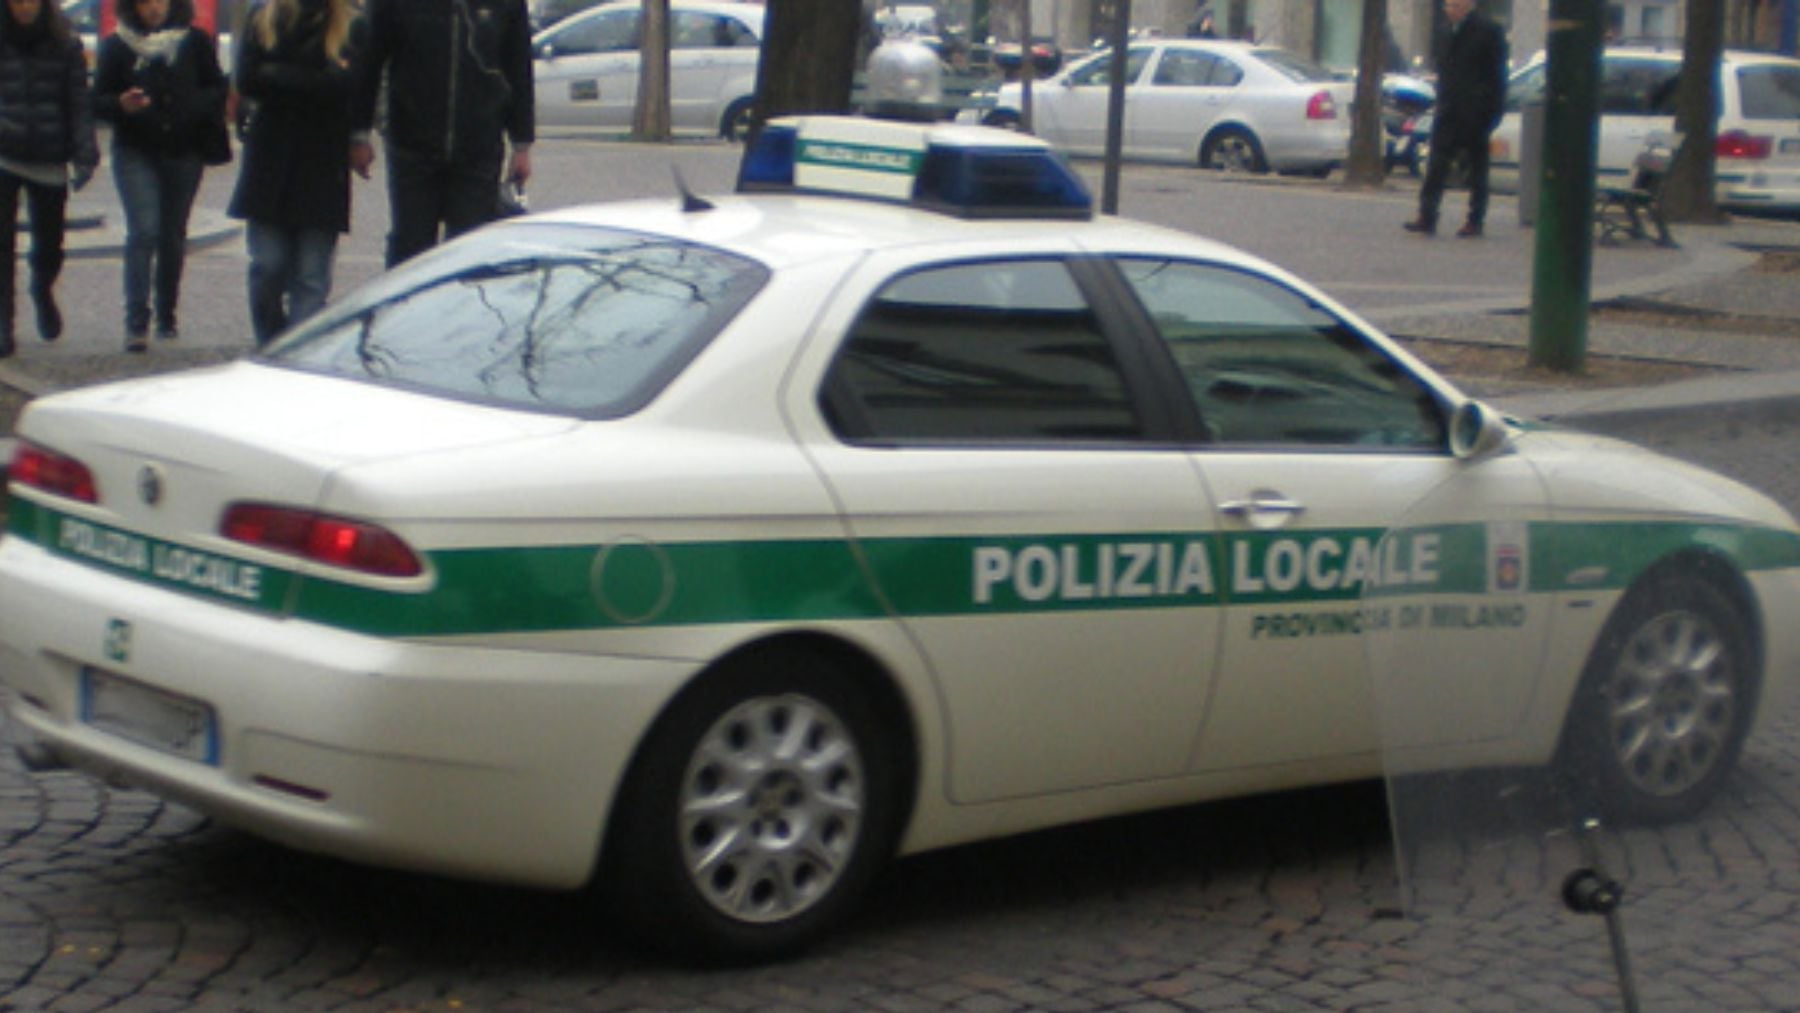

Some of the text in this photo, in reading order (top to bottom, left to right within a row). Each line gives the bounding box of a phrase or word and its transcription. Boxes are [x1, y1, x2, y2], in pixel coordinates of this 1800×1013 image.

[152, 543, 261, 600] LOCALE
[973, 532, 1441, 604] POLIZIA LOCALE
[1252, 603, 1526, 639] PROVINCIA DI MILANO
